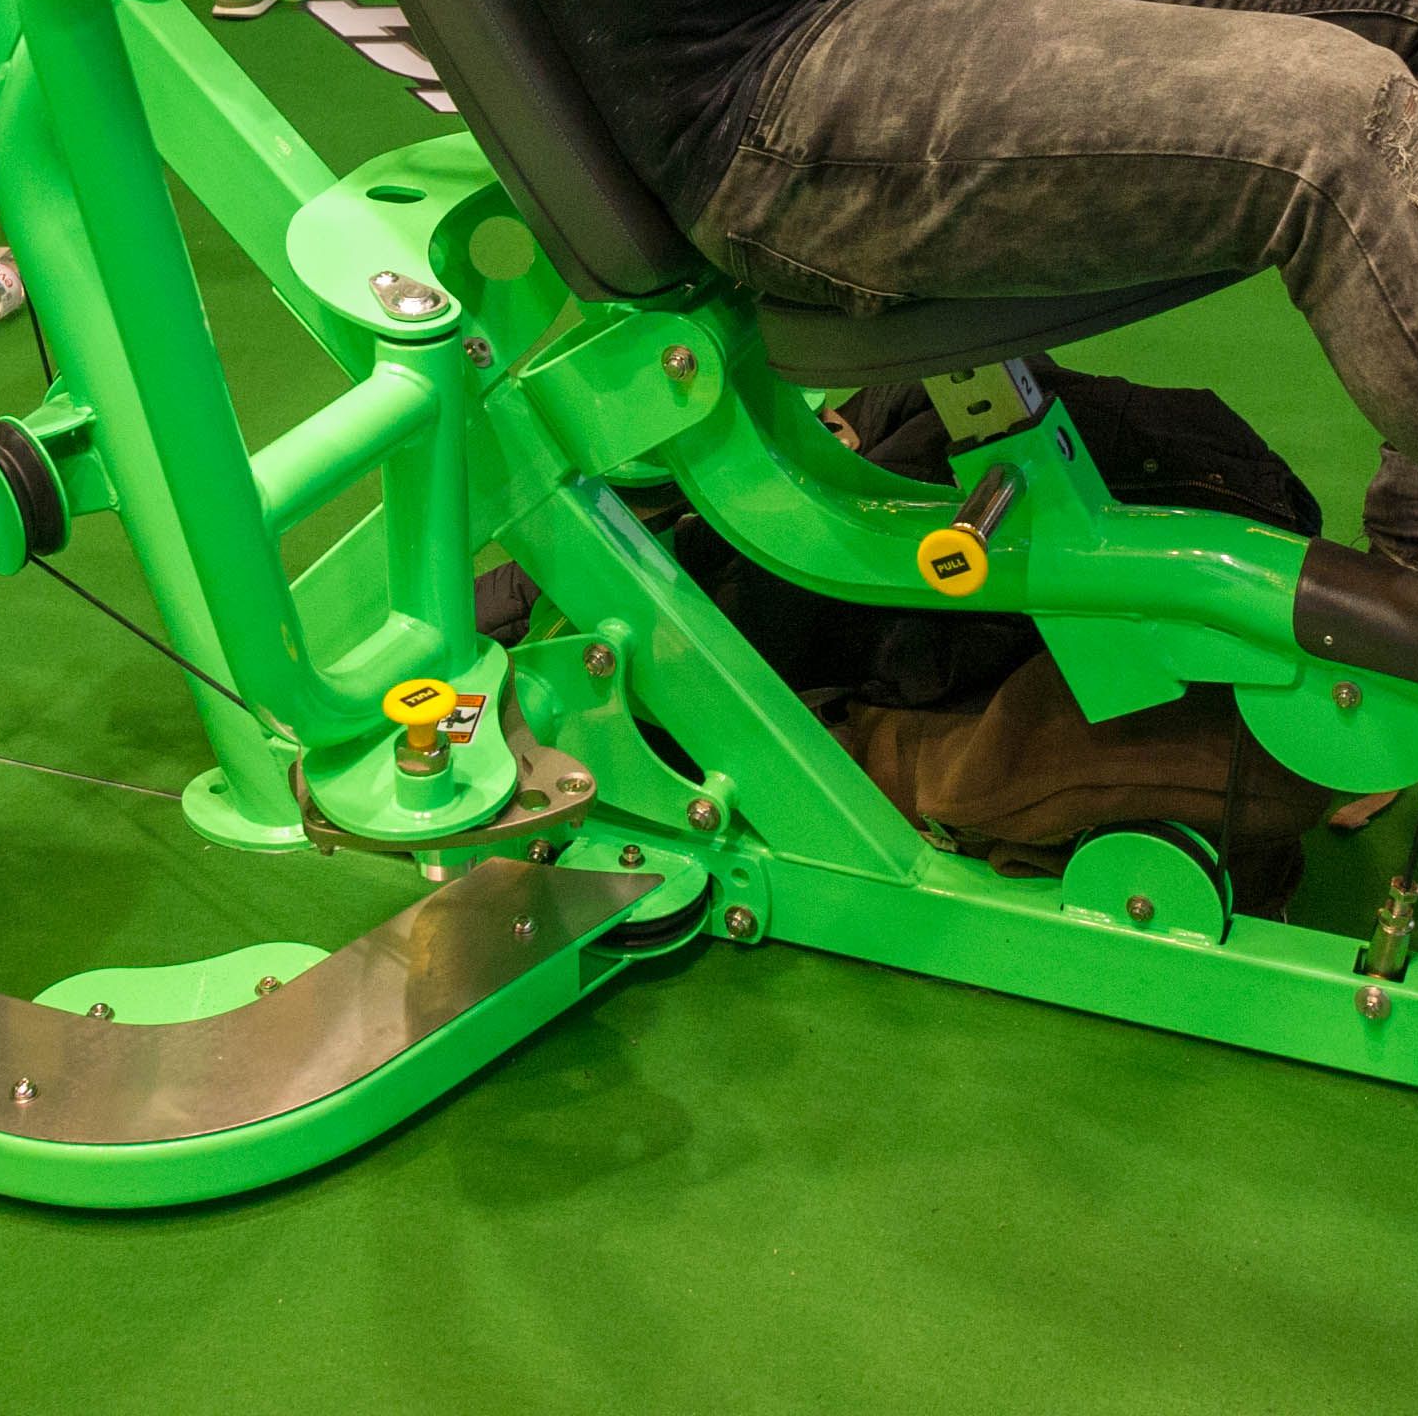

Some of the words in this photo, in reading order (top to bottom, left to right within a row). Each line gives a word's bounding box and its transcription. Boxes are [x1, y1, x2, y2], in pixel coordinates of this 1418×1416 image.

[1022, 376, 1032, 395] 2
[936, 559, 966, 574] PULL
[404, 688, 435, 704] PULL
